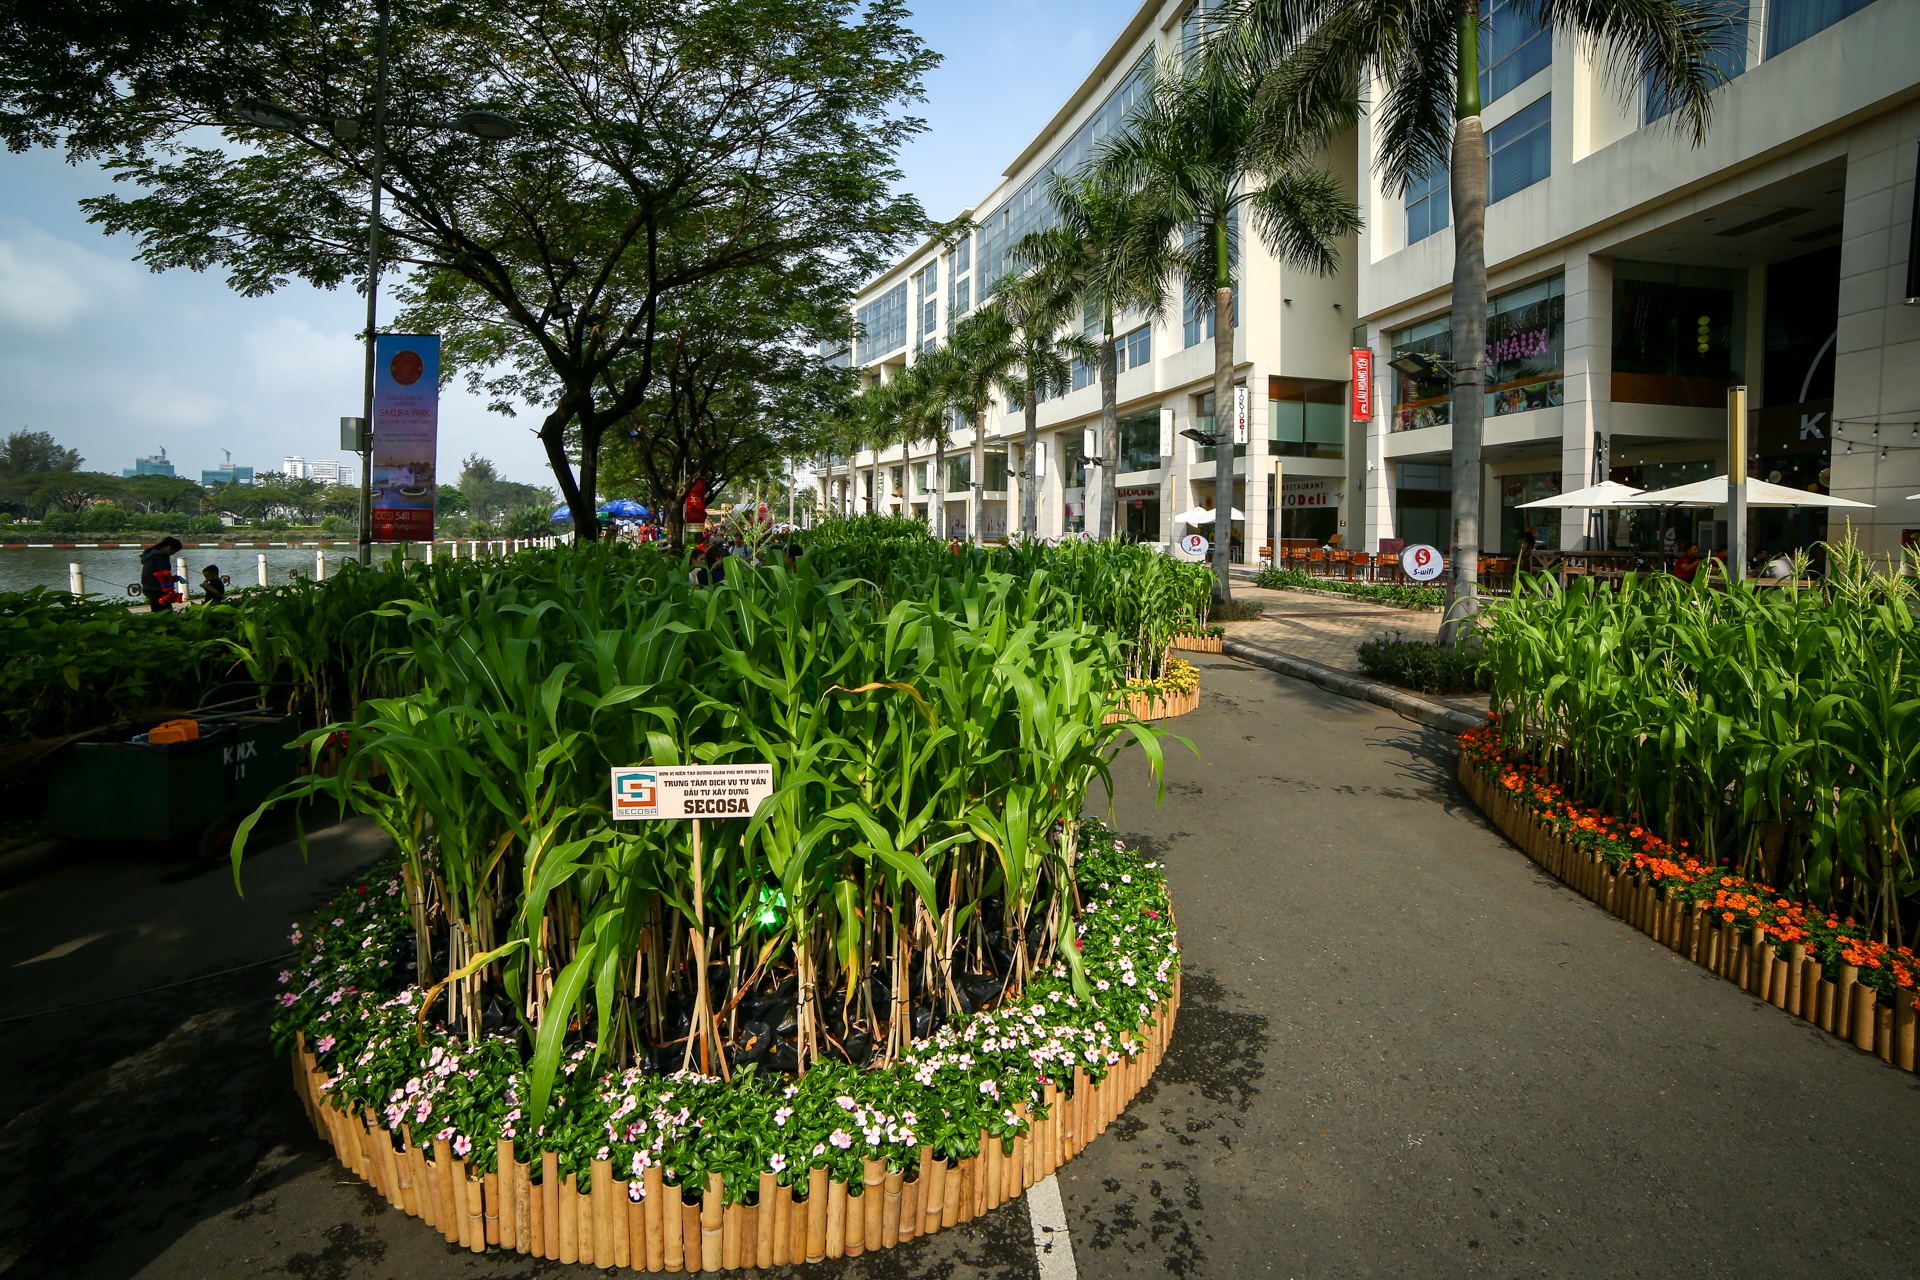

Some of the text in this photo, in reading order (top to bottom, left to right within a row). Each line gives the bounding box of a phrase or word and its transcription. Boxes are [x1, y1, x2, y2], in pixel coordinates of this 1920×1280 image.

[379, 408, 431, 417] SAKURA PARK
[1800, 412, 1833, 441] K
[1282, 482, 1324, 491] RESTAURANT
[395, 511, 410, 520] 5411
[1413, 567, 1434, 576] S-wifi
[690, 779, 707, 787] TÂM
[709, 779, 726, 787] DỊCH
[728, 778, 738, 787] VỤ
[739, 778, 750, 786] TƯ
[751, 776, 767, 785] VẤN
[683, 787, 749, 797] ĐẦU TƯ XÂY DỰNG
[684, 798, 750, 814] SECOSA
[618, 808, 657, 816] SECOSA
